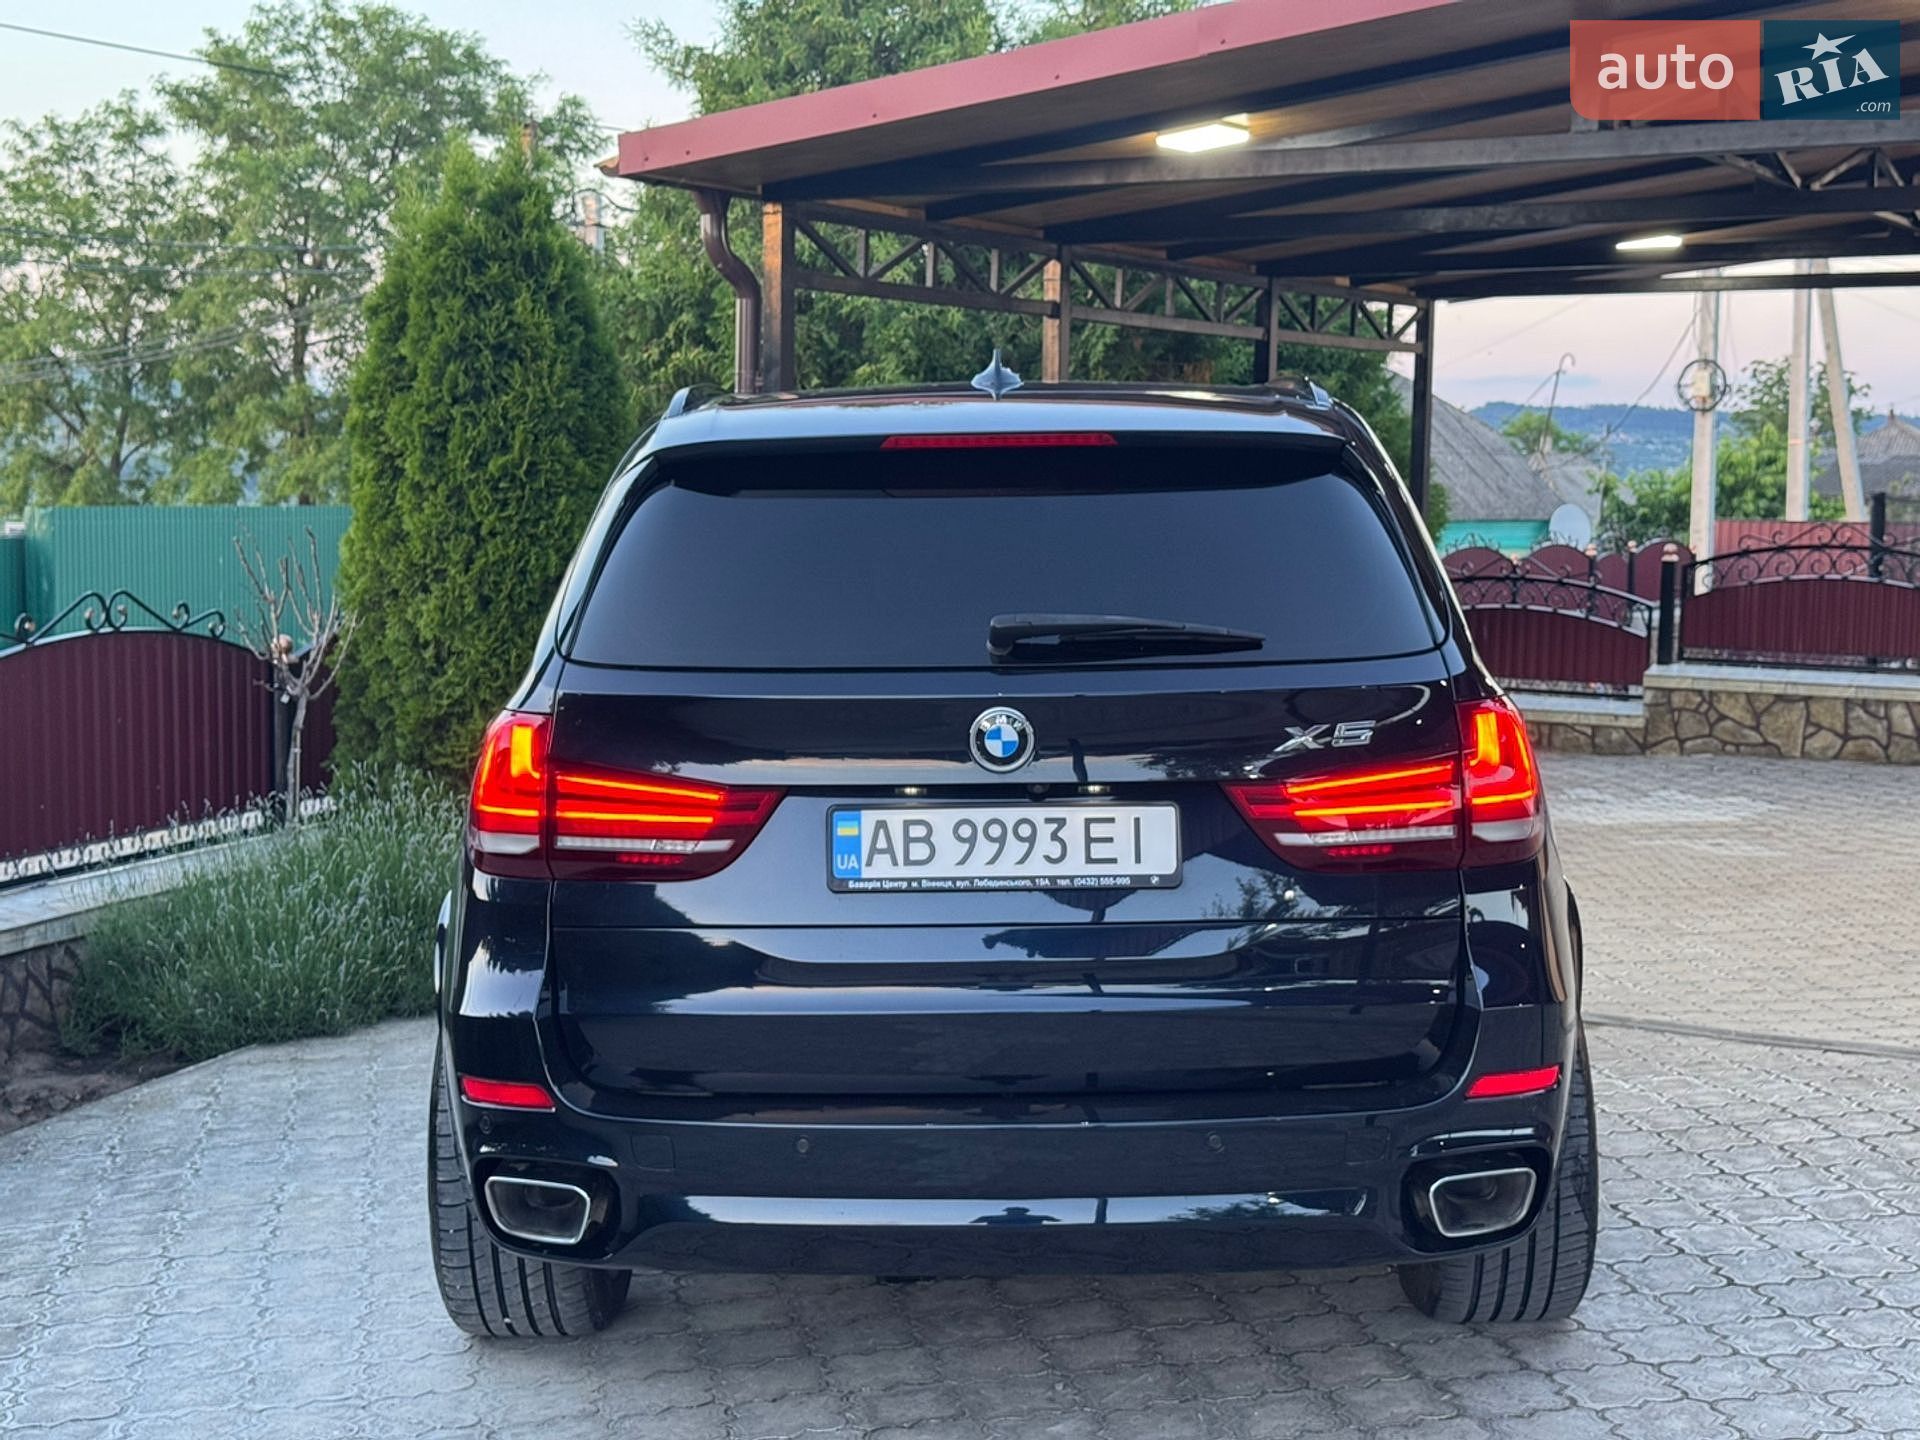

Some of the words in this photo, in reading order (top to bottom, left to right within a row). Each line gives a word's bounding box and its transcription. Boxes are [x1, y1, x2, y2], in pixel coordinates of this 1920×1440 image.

[1272, 720, 1376, 752] X5
[865, 819, 936, 867] AB
[952, 817, 1067, 866] 9993
[1084, 816, 1142, 865] EI
[837, 854, 859, 869] UA
